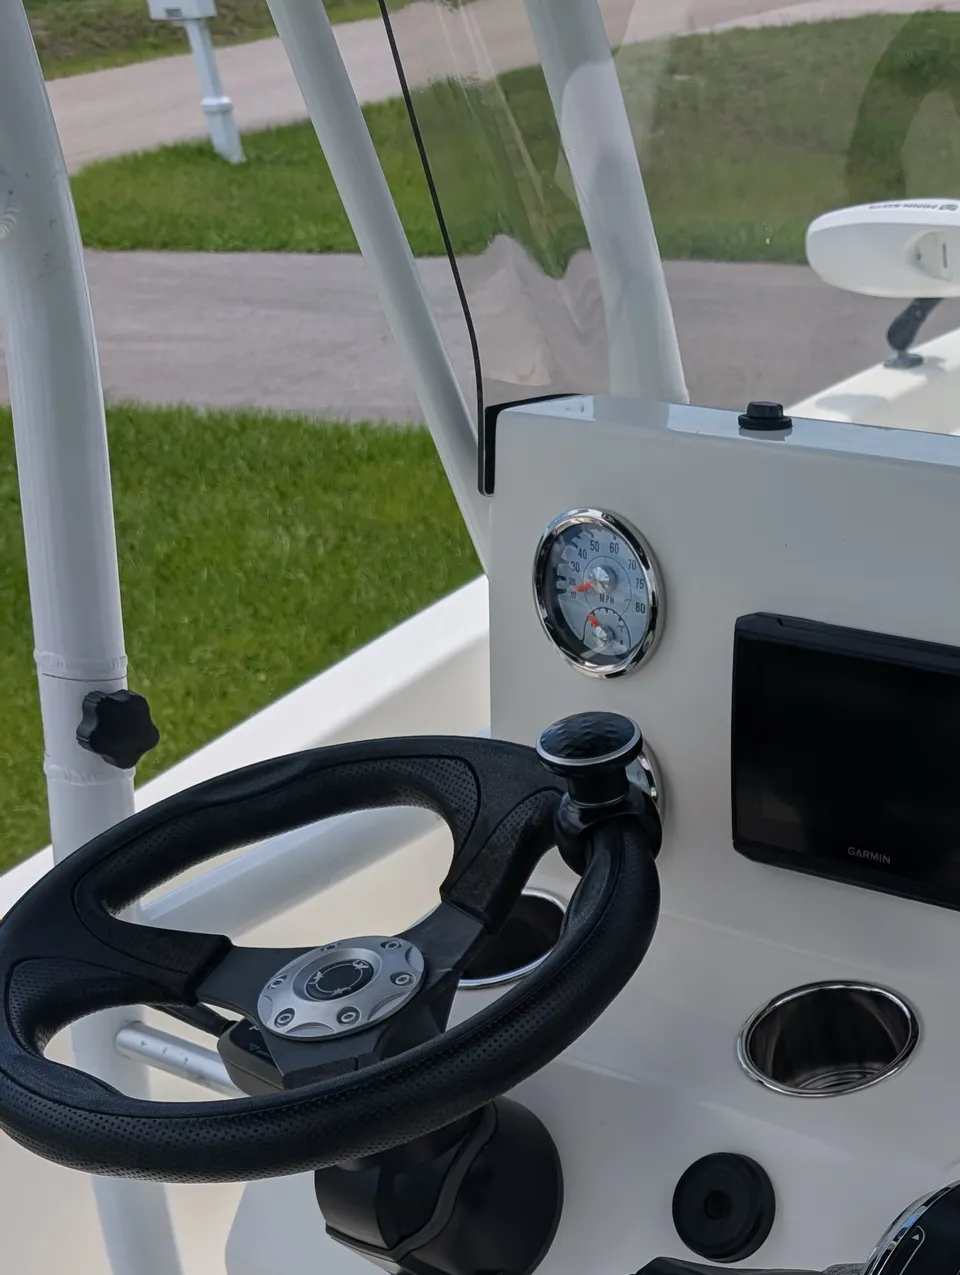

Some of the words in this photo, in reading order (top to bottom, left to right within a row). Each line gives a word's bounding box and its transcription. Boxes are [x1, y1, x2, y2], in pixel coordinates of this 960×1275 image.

[590, 540, 600, 552] 50
[609, 542, 620, 555] 60
[578, 548, 588, 560] 40
[571, 561, 580, 573] 30
[627, 559, 637, 571] 70
[635, 578, 644, 590] 75
[635, 602, 646, 614] 80
[847, 846, 891, 864] GARMIN
